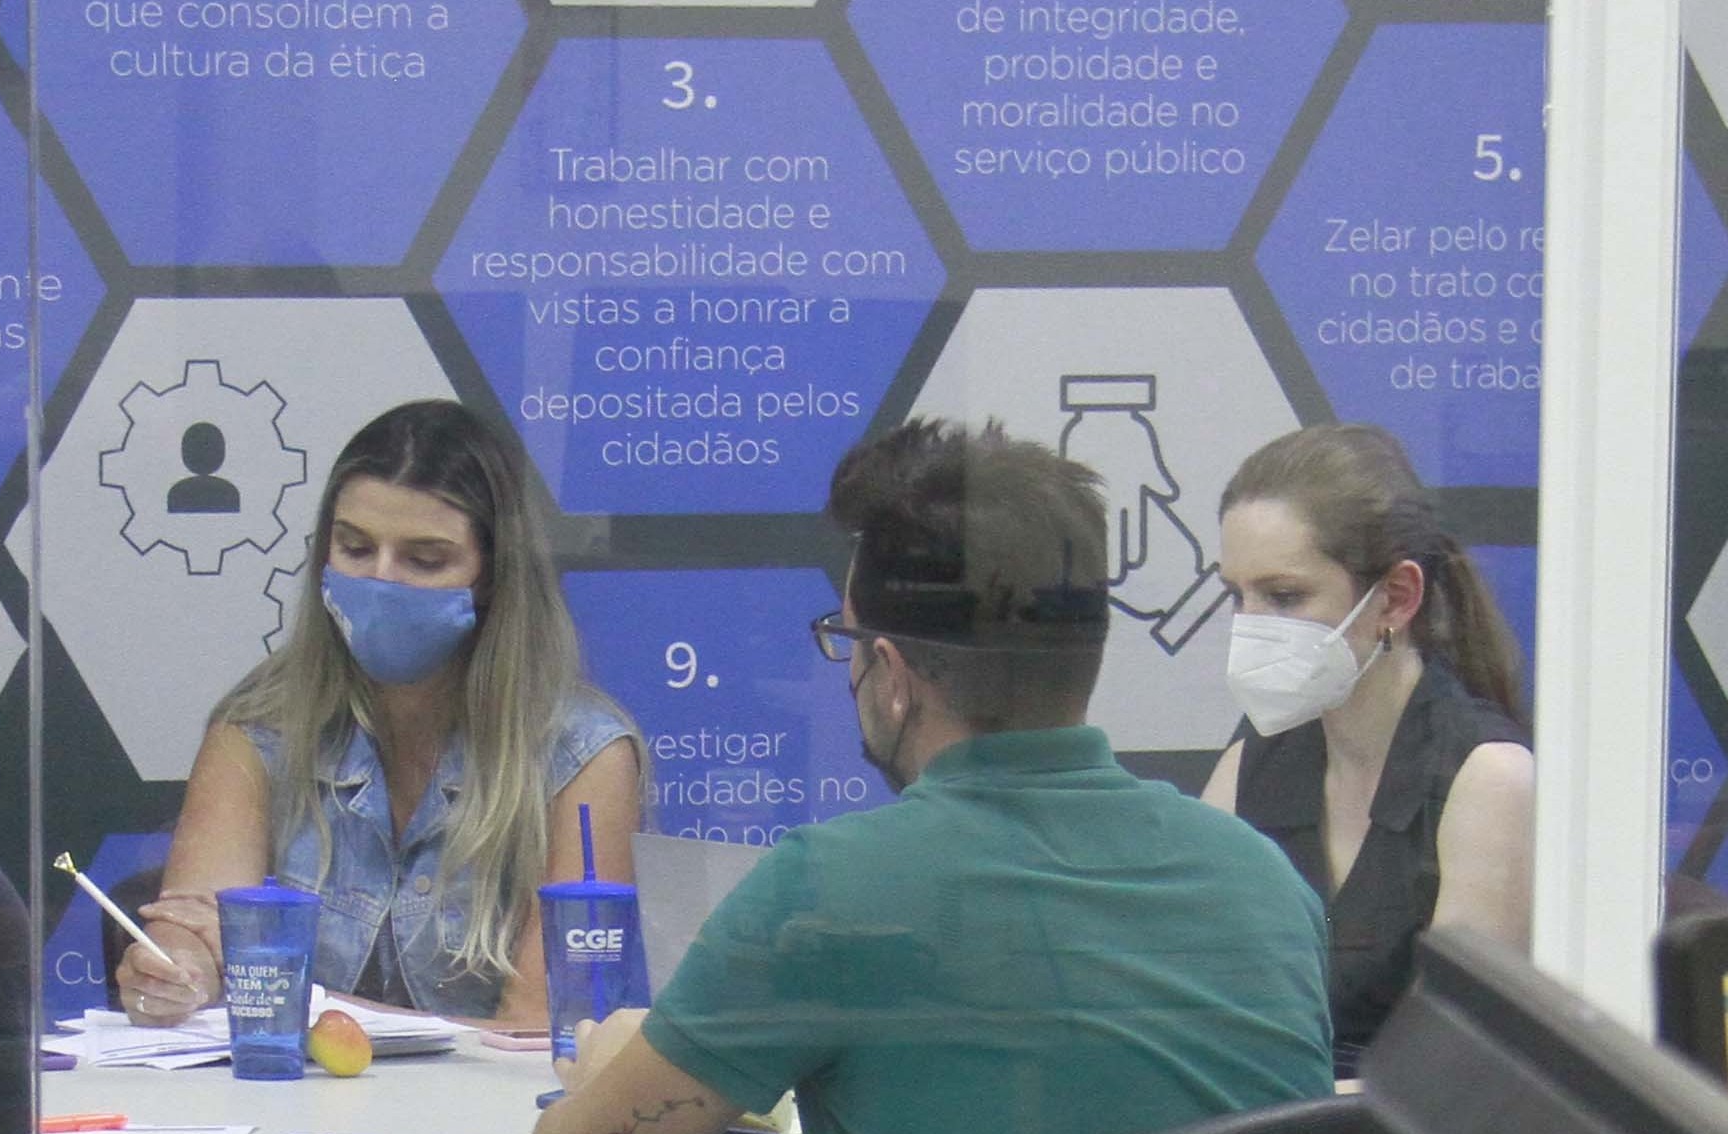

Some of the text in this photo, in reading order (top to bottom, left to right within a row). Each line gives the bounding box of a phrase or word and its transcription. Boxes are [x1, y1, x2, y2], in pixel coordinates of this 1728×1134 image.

[85, 0, 448, 31] que consolidem a
[957, 0, 1244, 39] de integridade,
[111, 42, 426, 80] cultura da ética
[985, 50, 1217, 83] probidade e
[662, 60, 717, 109] 3.
[963, 96, 1239, 127] moralidade no
[550, 148, 828, 182] Trabalhar com
[954, 142, 1245, 178] serviço público
[1473, 133, 1522, 182] 5.
[549, 196, 831, 229] honestidade e
[1324, 218, 1415, 252] Zelar
[1429, 218, 1508, 257] pelo
[472, 244, 905, 282] responsabilidade com
[1351, 273, 1396, 297] no
[1408, 266, 1497, 298] trato
[530, 293, 850, 324] vistas a honrar a
[1318, 312, 1486, 344] cidadãos
[1499, 319, 1517, 343] e
[595, 336, 785, 375] confiança
[1391, 359, 1437, 389] de
[520, 383, 860, 423] depositada pelos
[602, 432, 780, 466] cidadãos
[664, 641, 720, 689] 9.
[820, 777, 867, 802] no
[566, 928, 624, 950] CGE
[248, 966, 278, 979] QUEM
